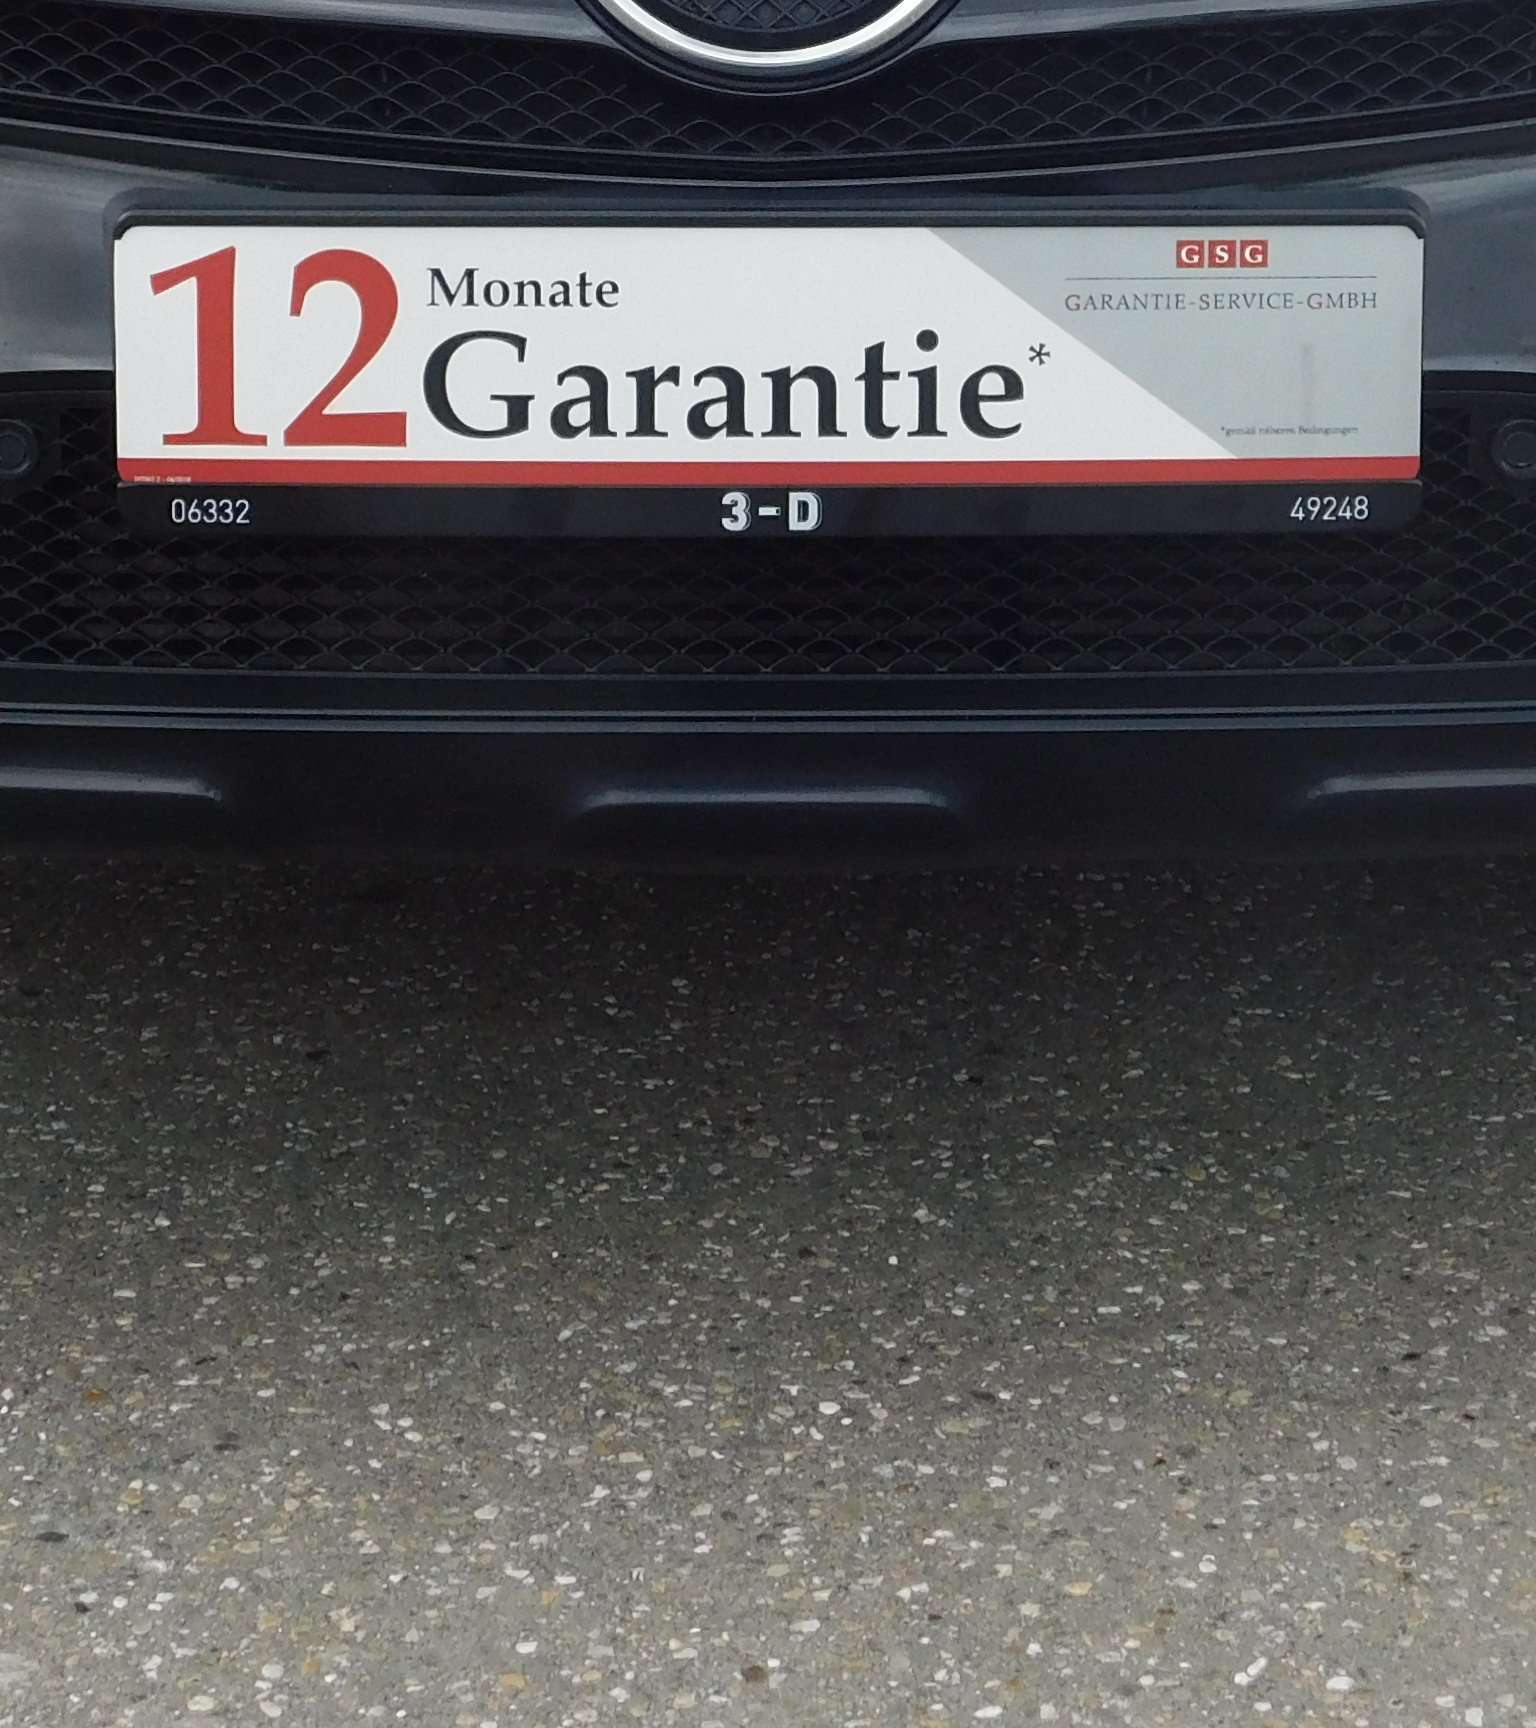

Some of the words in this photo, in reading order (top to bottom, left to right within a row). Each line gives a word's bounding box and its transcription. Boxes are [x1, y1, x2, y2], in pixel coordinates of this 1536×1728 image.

[1179, 242, 1266, 266] GSG
[426, 267, 620, 308] Monate
[1065, 292, 1378, 313] GARANTIE-SERVICE-GMBH
[150, 245, 407, 447] 12
[171, 498, 250, 523] 06332
[1289, 495, 1370, 522] 49248
